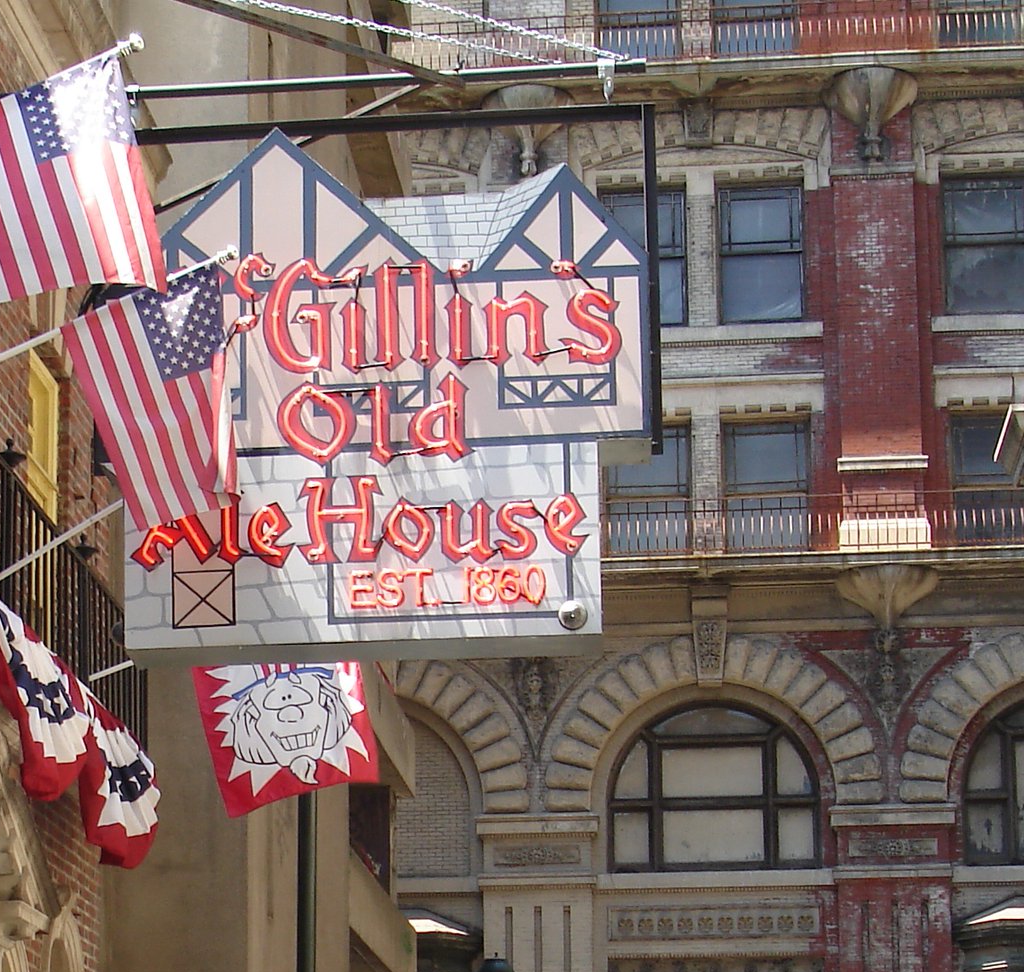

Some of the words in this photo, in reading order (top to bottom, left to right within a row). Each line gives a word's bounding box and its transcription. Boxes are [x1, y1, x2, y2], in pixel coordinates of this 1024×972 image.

[277, 372, 475, 466] Old
[296, 476, 590, 567] House
[462, 564, 546, 607] 1860
